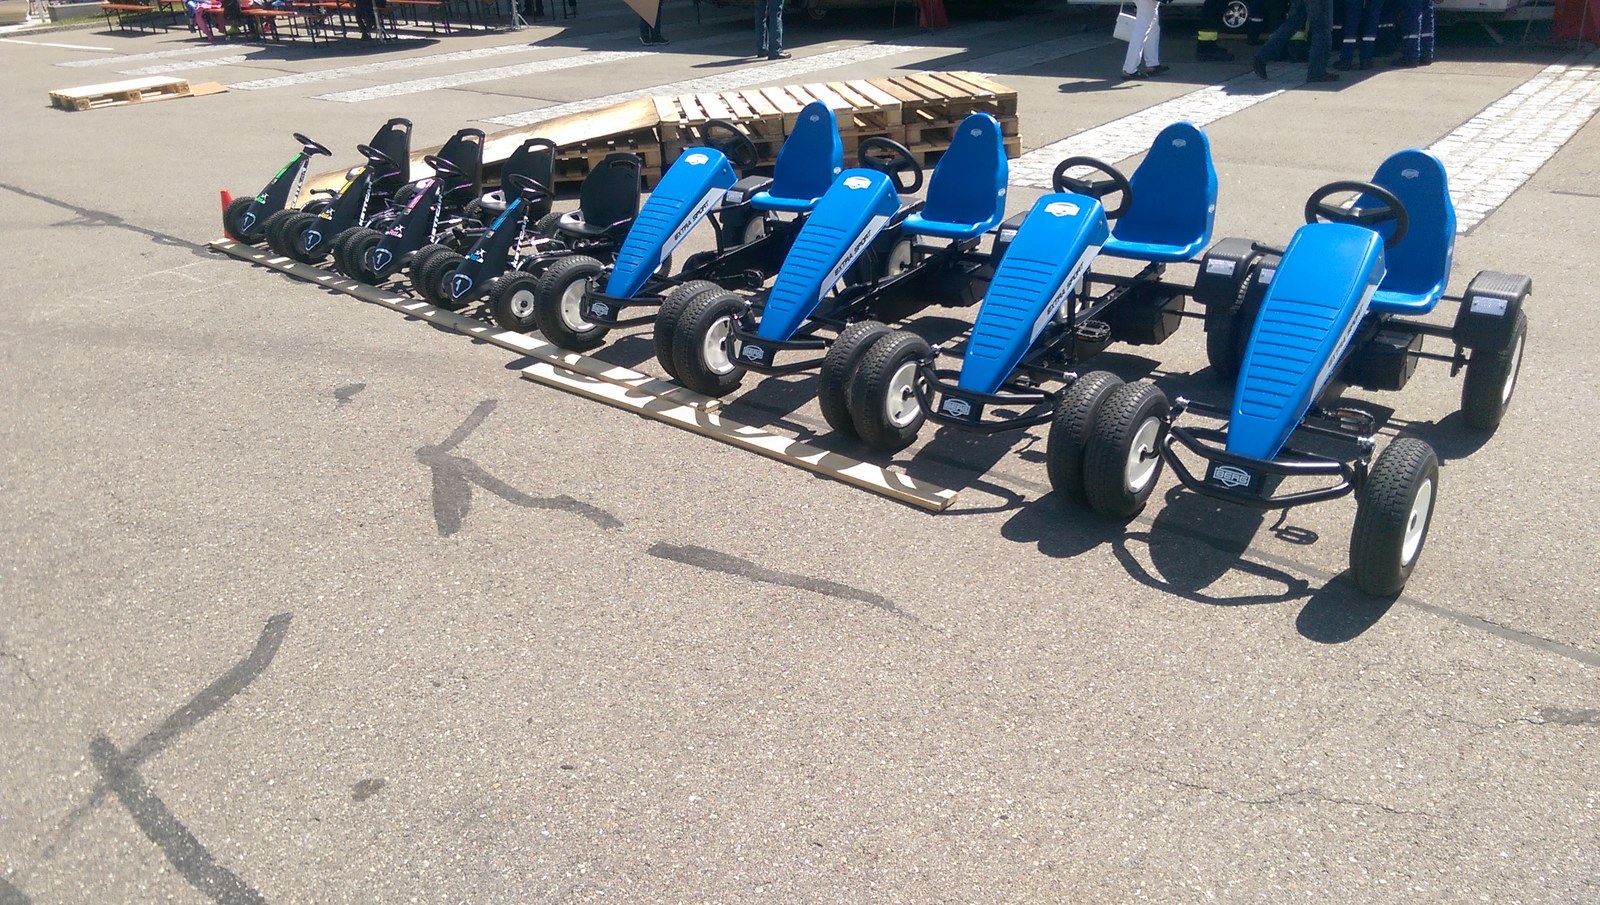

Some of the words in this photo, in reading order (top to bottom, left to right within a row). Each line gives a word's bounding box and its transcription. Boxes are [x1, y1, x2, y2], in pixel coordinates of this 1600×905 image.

[674, 221, 692, 241] EXTRA
[692, 199, 709, 221] SPORT
[834, 253, 853, 276] EXTRA
[853, 229, 872, 254] SPORT
[1046, 288, 1066, 316] EXTRA
[1066, 260, 1085, 290] SPORT
[943, 401, 970, 415] BERG
[1215, 468, 1249, 485] BERG
